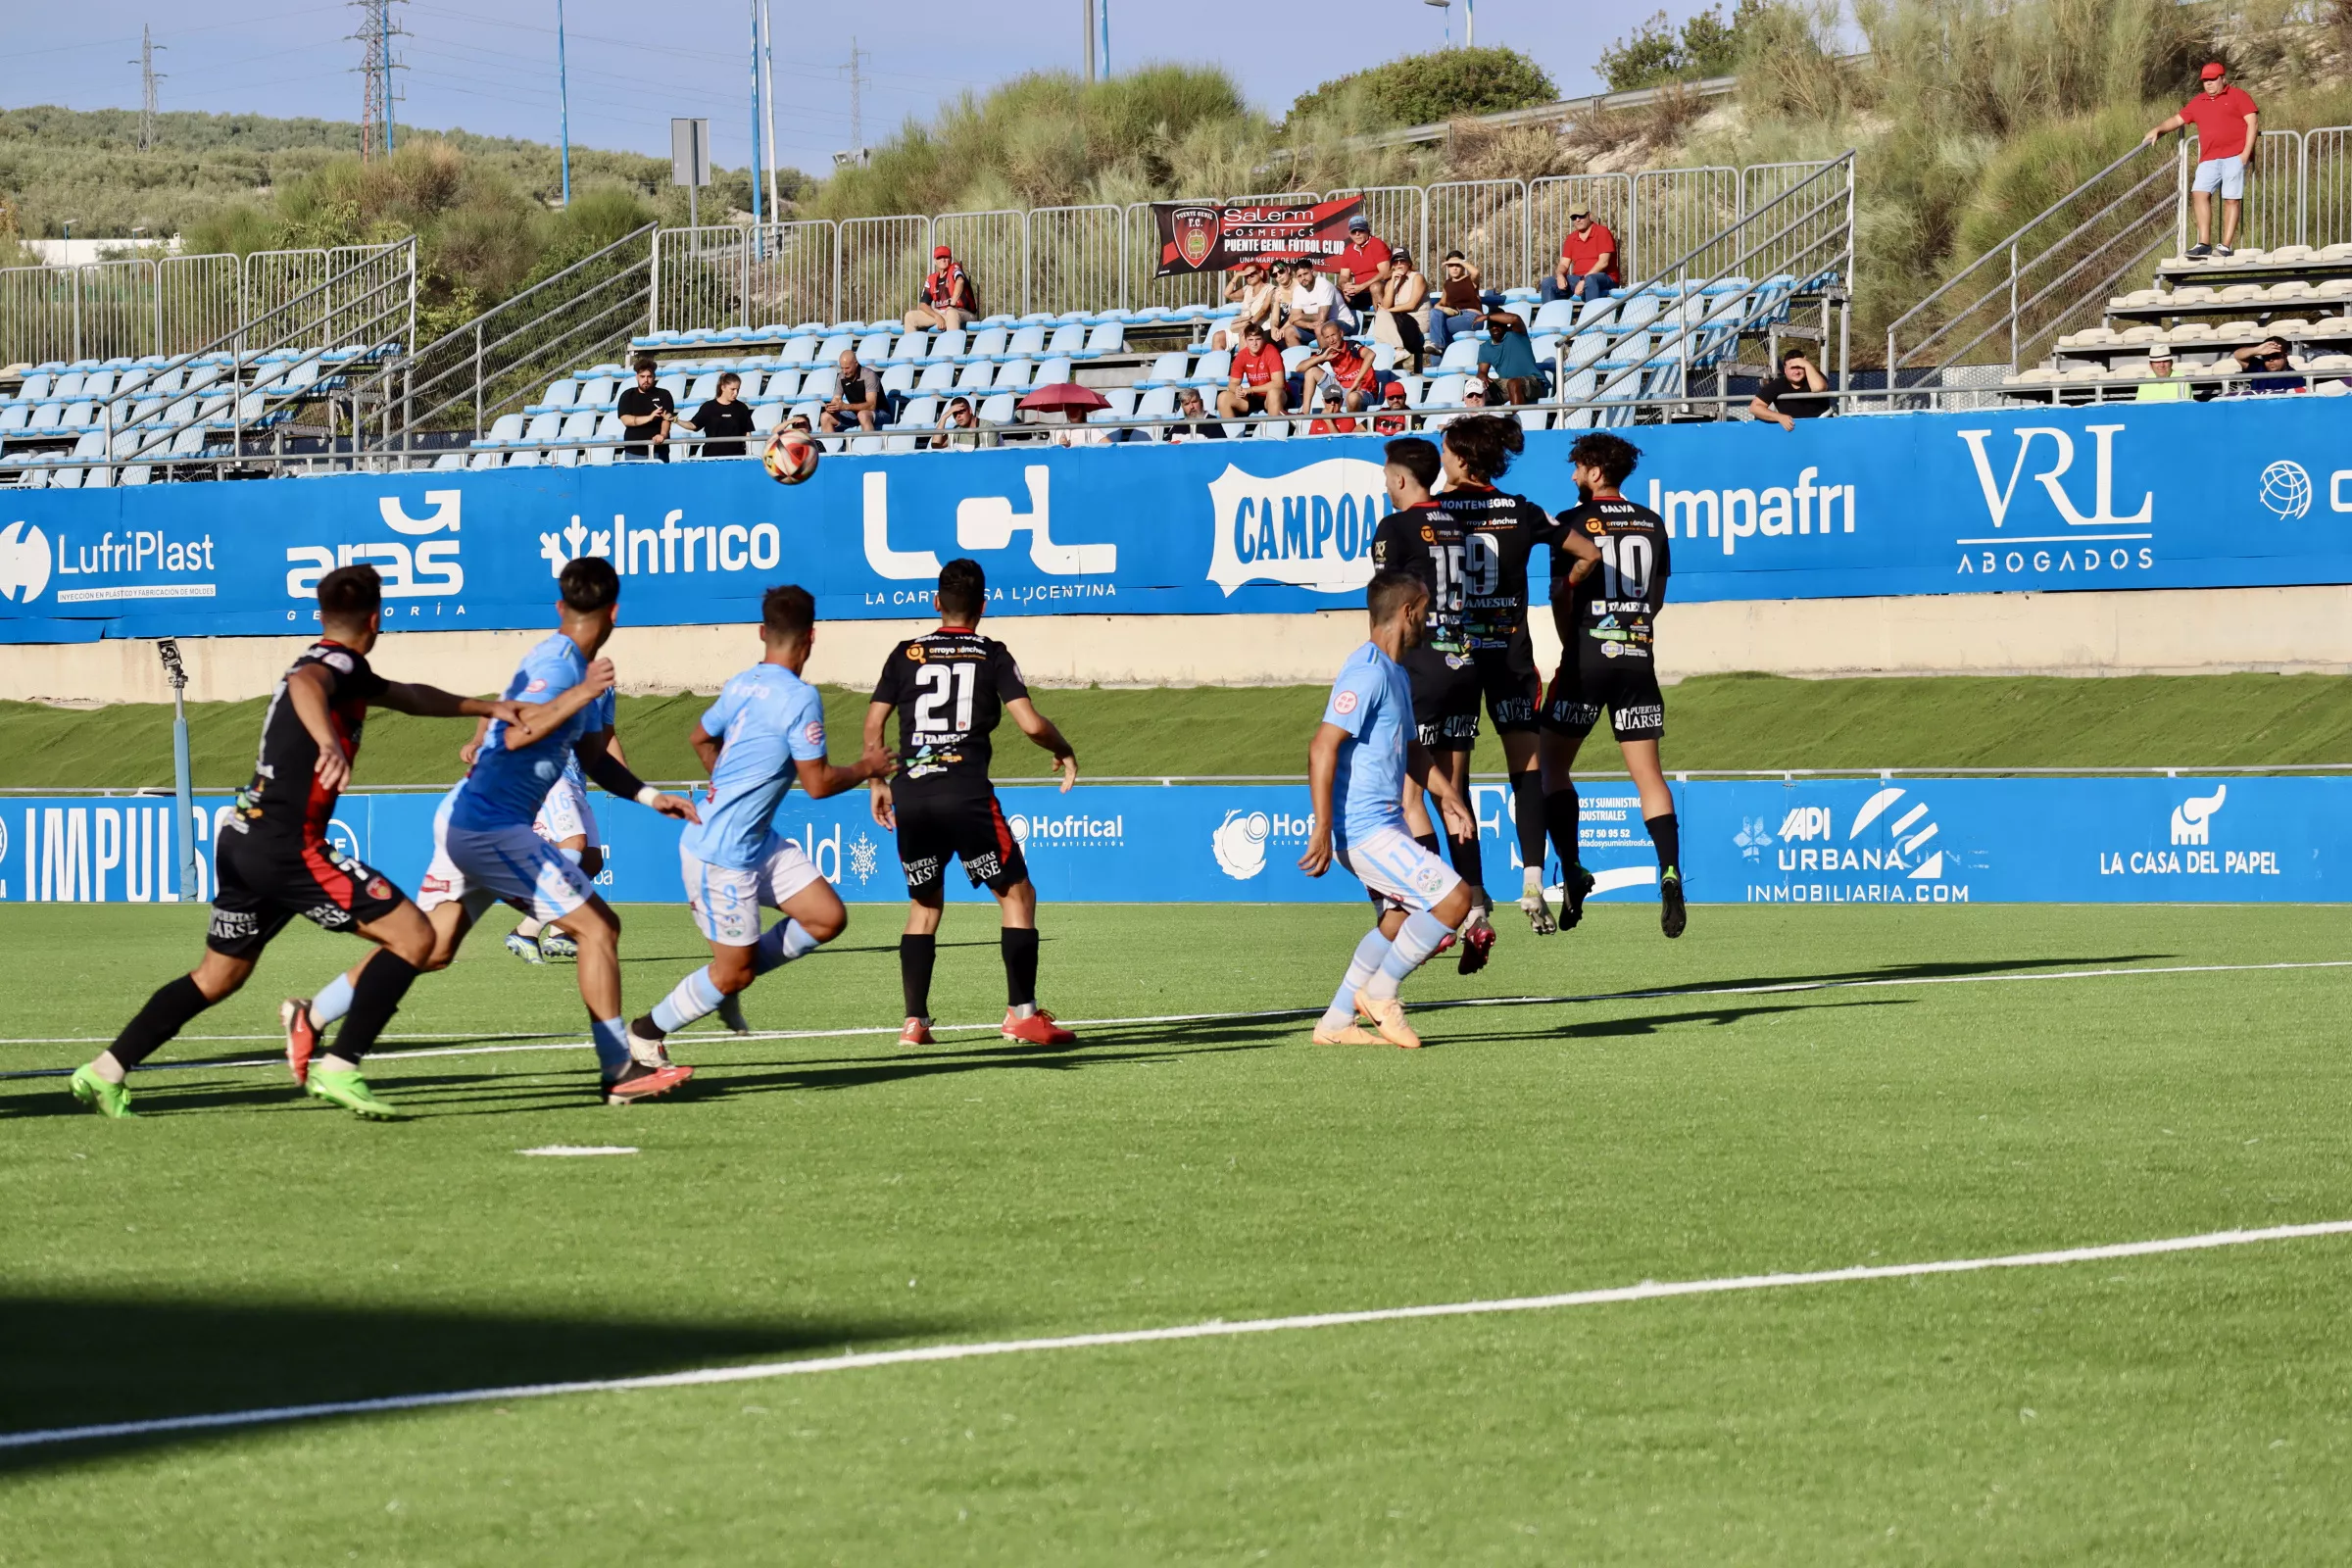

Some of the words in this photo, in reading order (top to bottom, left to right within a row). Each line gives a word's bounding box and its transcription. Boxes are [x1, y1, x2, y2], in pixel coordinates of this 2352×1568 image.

[1223, 208, 1313, 222] Salerm
[1223, 228, 1314, 237] COSMETICS
[1224, 238, 1259, 252] PUENTE
[1260, 238, 1287, 252] GENIL
[1288, 237, 1321, 253] FÚTBOL
[1322, 239, 1346, 255] CLUB
[1957, 424, 2153, 528] VRL
[1439, 498, 1516, 510] MONTENEGRO
[1600, 504, 1635, 513] SALVA
[1648, 466, 1855, 556] Impafri
[1234, 493, 1394, 564] CAMPOA
[58, 530, 216, 575] LufriPlast
[613, 509, 781, 575] Infrico
[286, 540, 465, 599] aras
[1466, 533, 1498, 595] 9
[1593, 534, 1653, 600] 10
[1956, 548, 2154, 574] ABOGADOS
[1428, 545, 1467, 612] 15
[865, 592, 886, 605] LA
[893, 587, 1004, 605] CARTSA
[1465, 597, 1517, 608] AMESUR
[286, 602, 466, 620] GEORÍA
[914, 662, 976, 732] 21
[1630, 704, 1661, 716] PUERTAS
[1631, 712, 1663, 729] ARSE
[1590, 798, 1595, 808] Y
[1595, 797, 1642, 808] SUMINISTRO
[1032, 814, 1123, 838] Hofrical
[1578, 809, 1627, 821] NDUSTRIALES
[1777, 808, 1831, 842] API
[1580, 829, 1595, 839] 957
[1596, 829, 1607, 839] 50
[1608, 829, 1619, 839] 95
[1620, 829, 1631, 839] 52
[1388, 841, 1426, 878] 11
[1778, 849, 1905, 871] URBANA
[2100, 852, 2125, 875] LA
[2130, 851, 2181, 874] CASA
[2186, 851, 2220, 874] DEL
[2225, 851, 2280, 875] PAPEL
[723, 884, 738, 911] 9
[1746, 884, 1969, 903] INMOBILIARIA.COM
